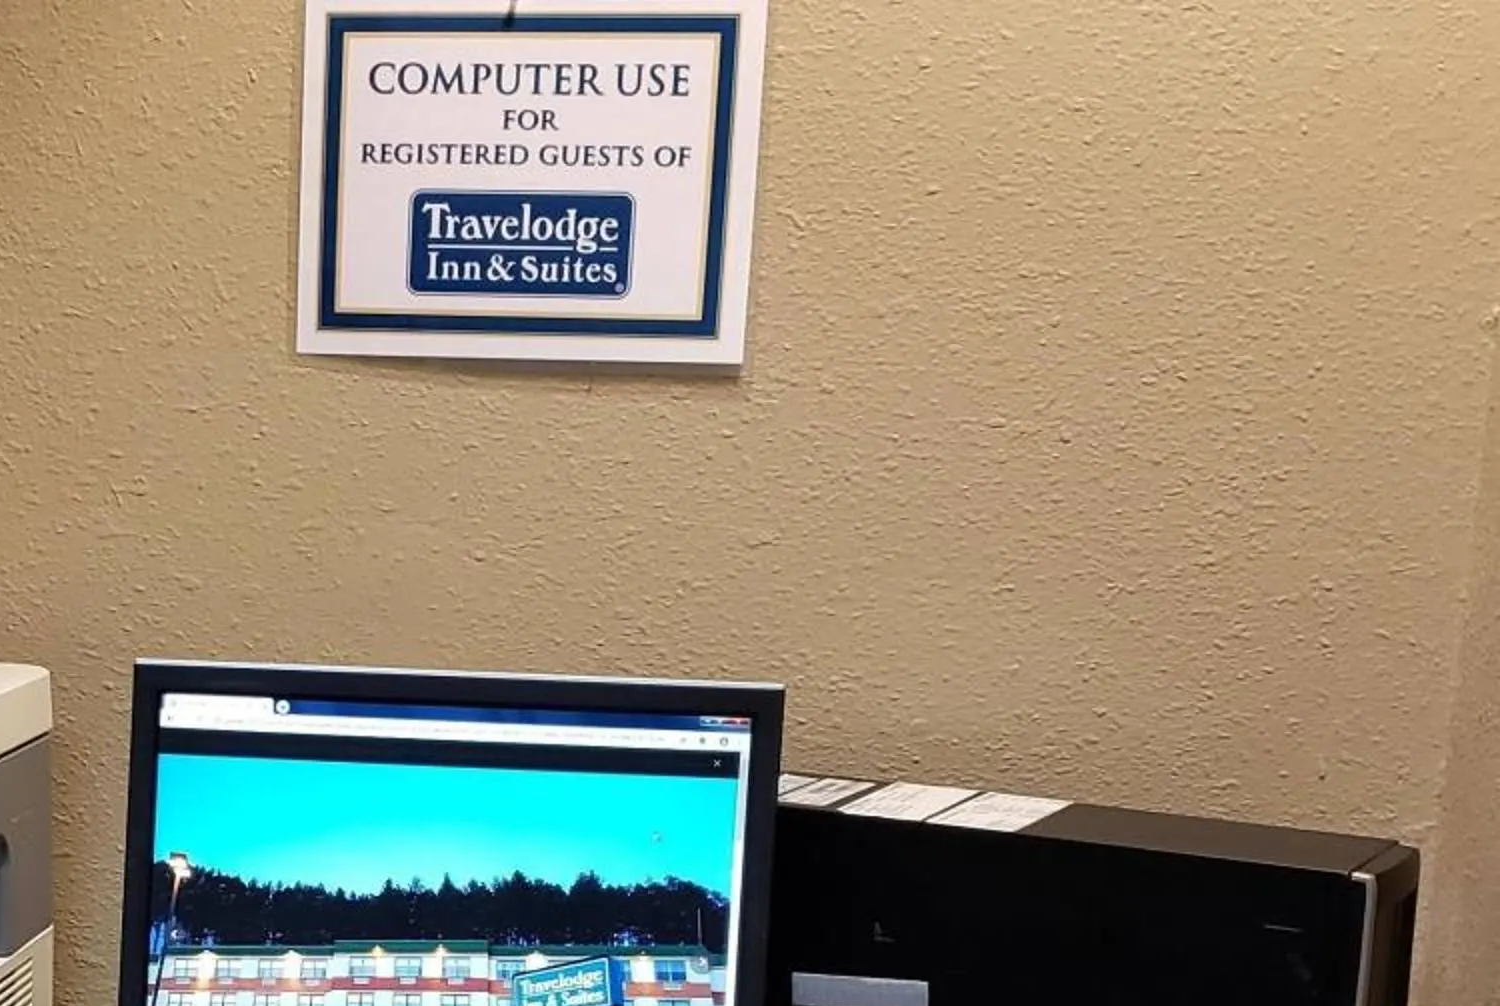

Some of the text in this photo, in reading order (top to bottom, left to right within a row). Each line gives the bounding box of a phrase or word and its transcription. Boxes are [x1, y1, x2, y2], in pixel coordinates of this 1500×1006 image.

[368, 61, 691, 97] COMPUTER USE
[502, 109, 559, 131] FOR
[361, 143, 693, 168] REGISTERED GUESTS OF
[422, 202, 619, 253] Travelodge
